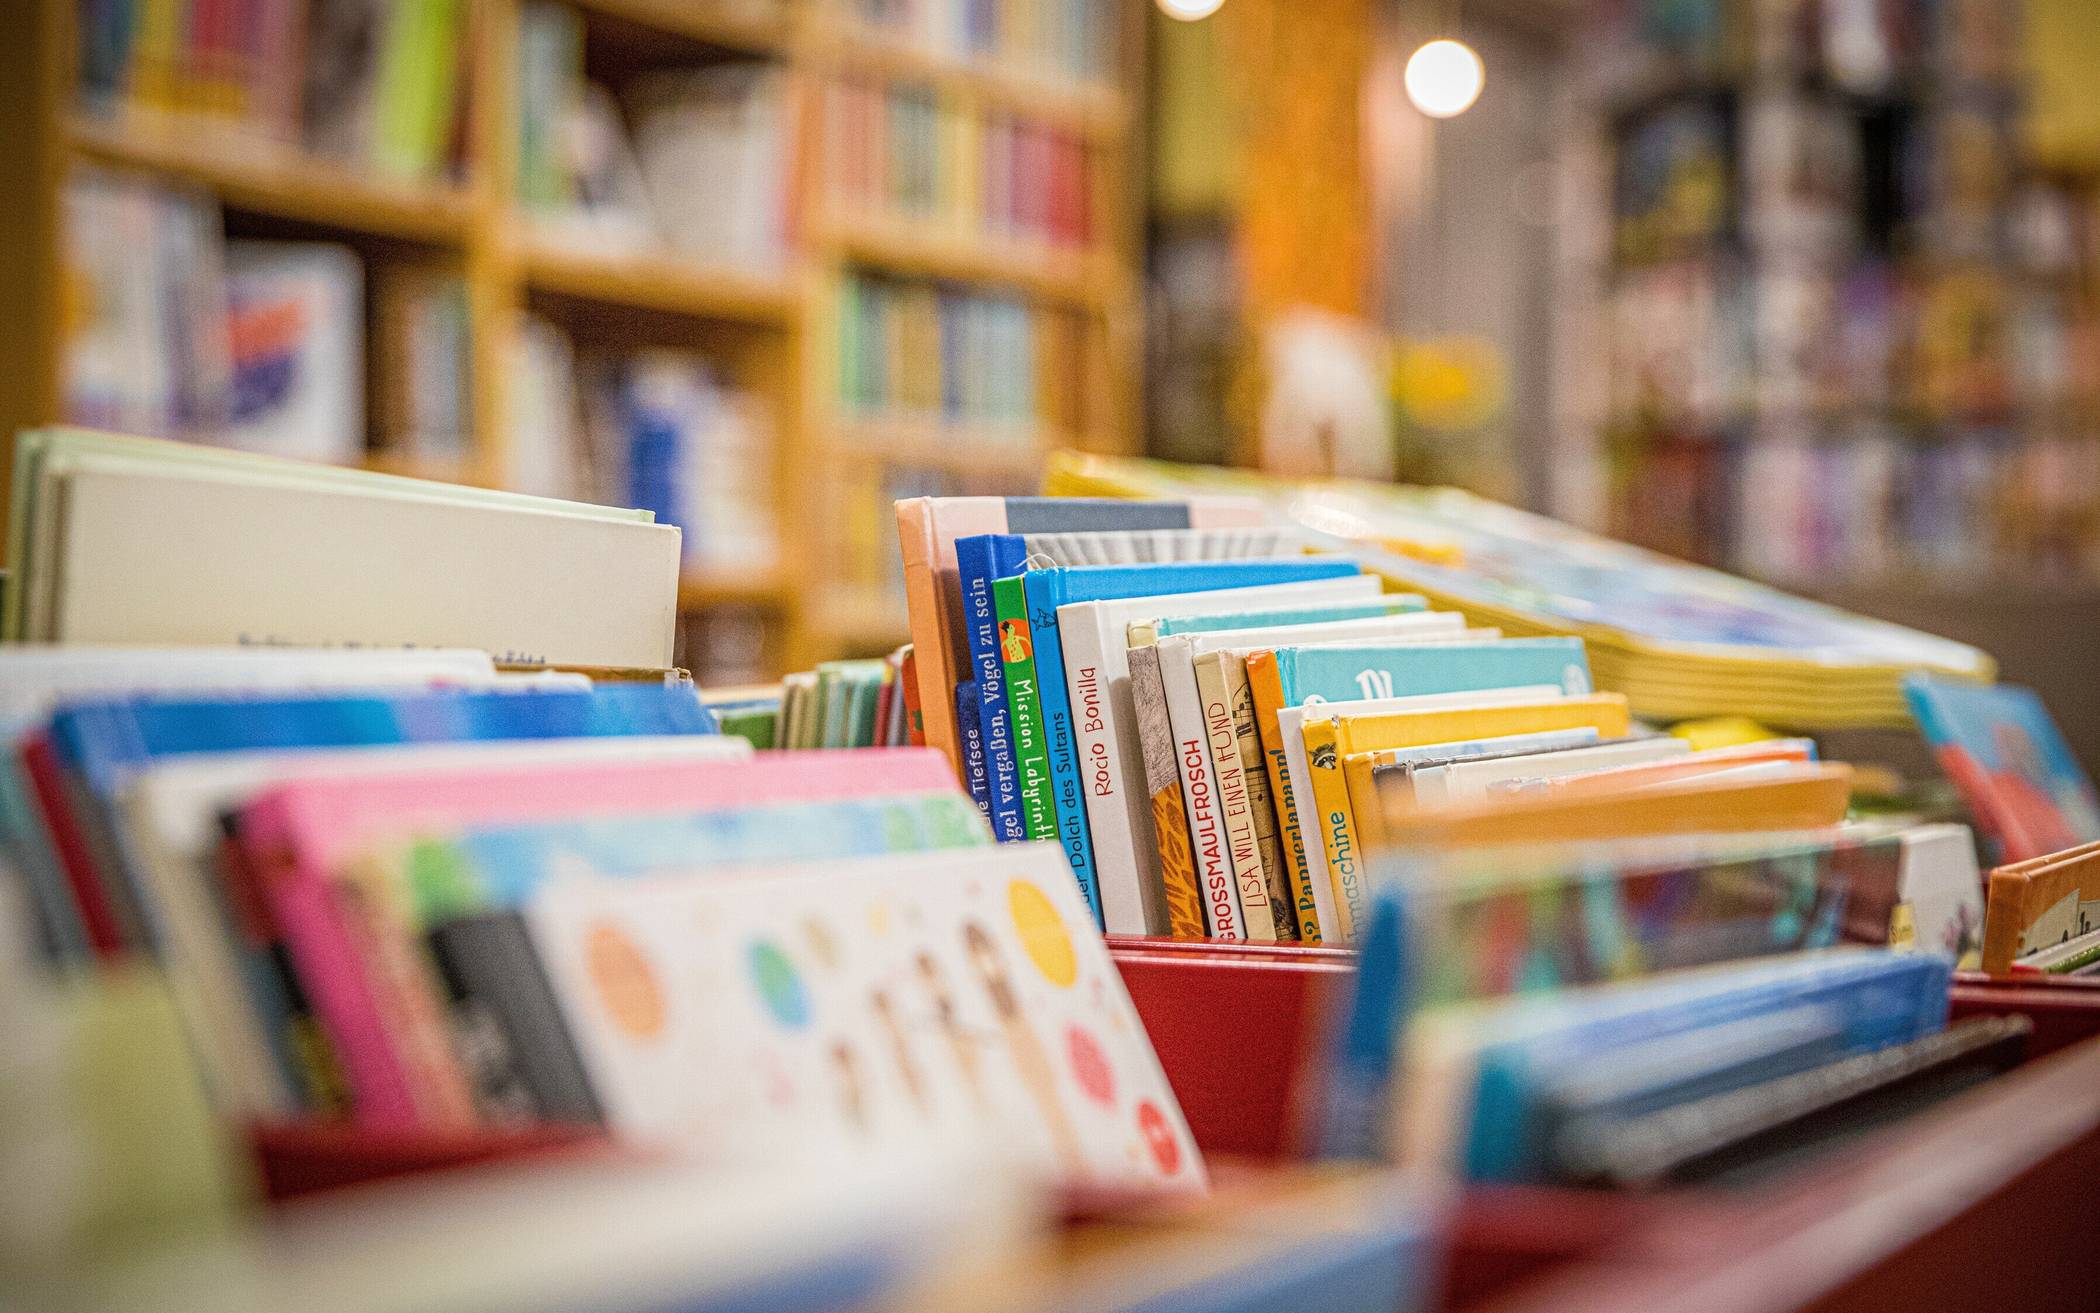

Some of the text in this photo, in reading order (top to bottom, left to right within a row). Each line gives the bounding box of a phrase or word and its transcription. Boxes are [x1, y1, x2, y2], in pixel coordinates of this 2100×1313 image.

[970, 577, 989, 617] sein
[979, 624, 993, 646] zu
[978, 651, 1001, 704] Vögel
[968, 728, 986, 794] Tiefsee
[990, 709, 1014, 803] vergaßen,
[1014, 679, 1054, 844] Mission Labyrinth
[1054, 712, 1071, 773] Sultans
[1077, 667, 1113, 797] Rocio Bonilla
[1062, 779, 1076, 808] des
[1208, 702, 1268, 907] LISA WILL EINEN HUND
[1065, 815, 1085, 867] Dolch
